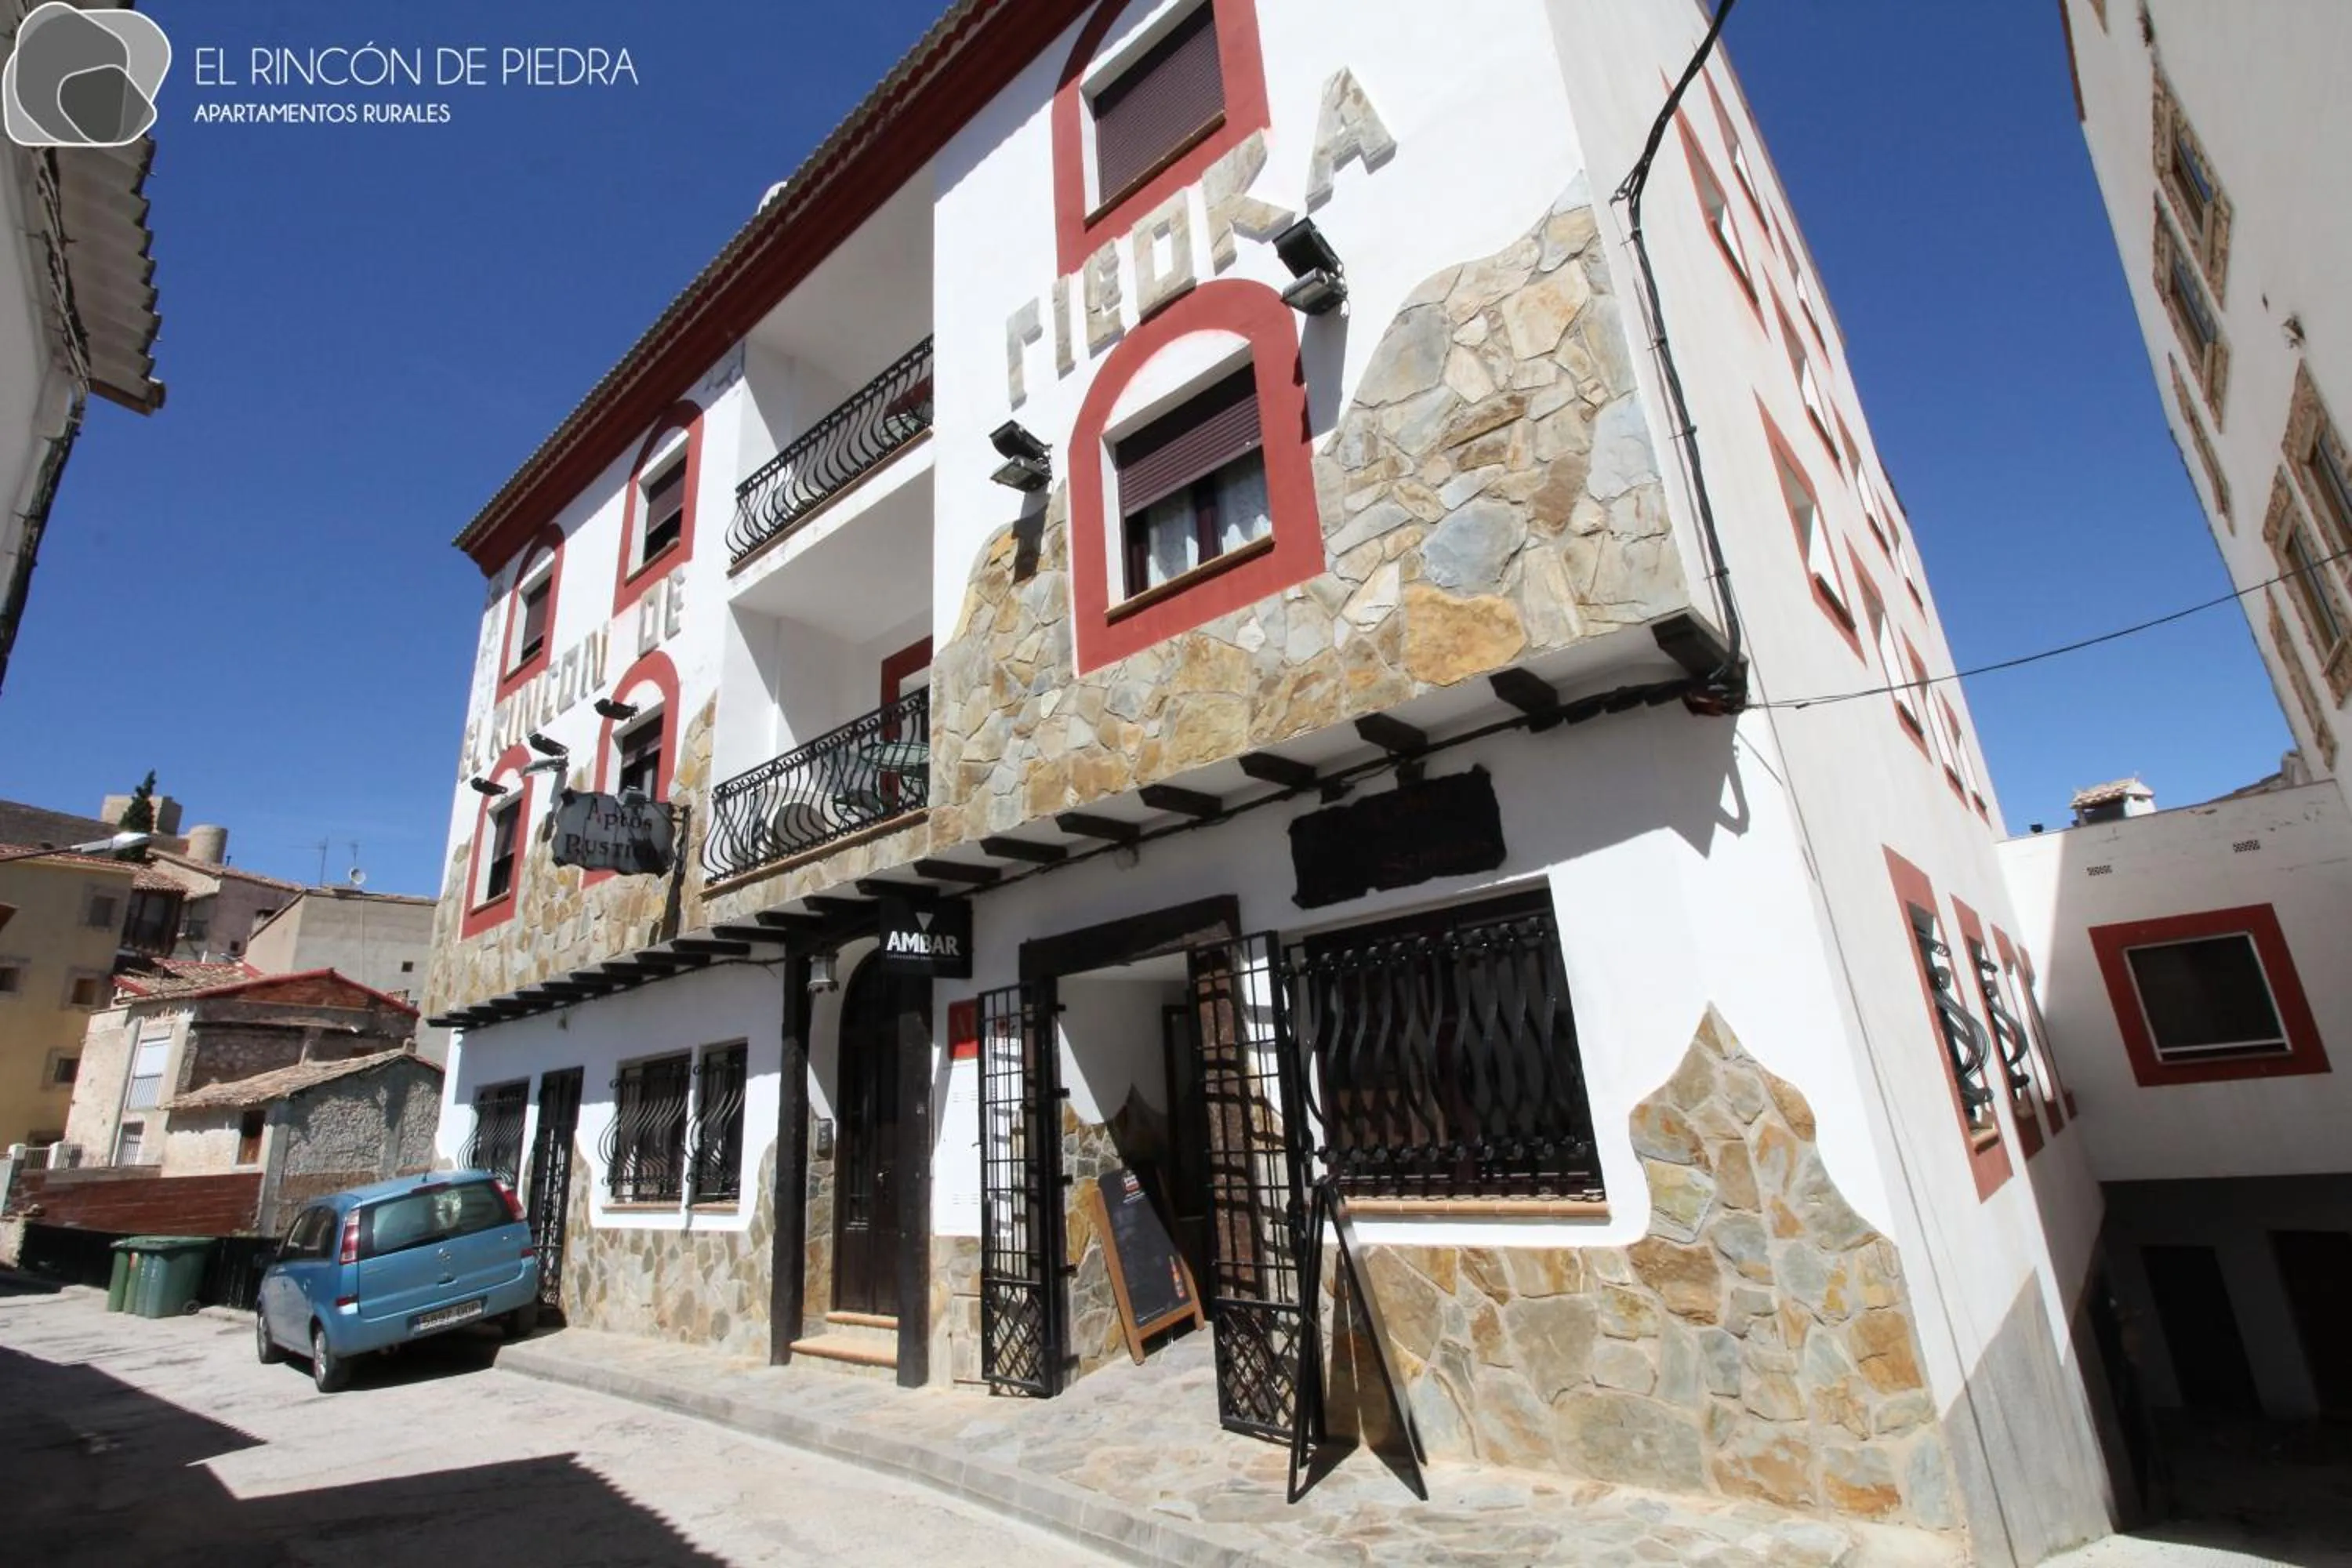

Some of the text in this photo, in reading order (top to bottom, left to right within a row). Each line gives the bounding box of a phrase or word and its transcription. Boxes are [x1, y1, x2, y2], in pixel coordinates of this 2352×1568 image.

[637, 564, 687, 660] DE
[1006, 66, 1398, 412] PIEDRA
[886, 931, 961, 956] AMBAR
